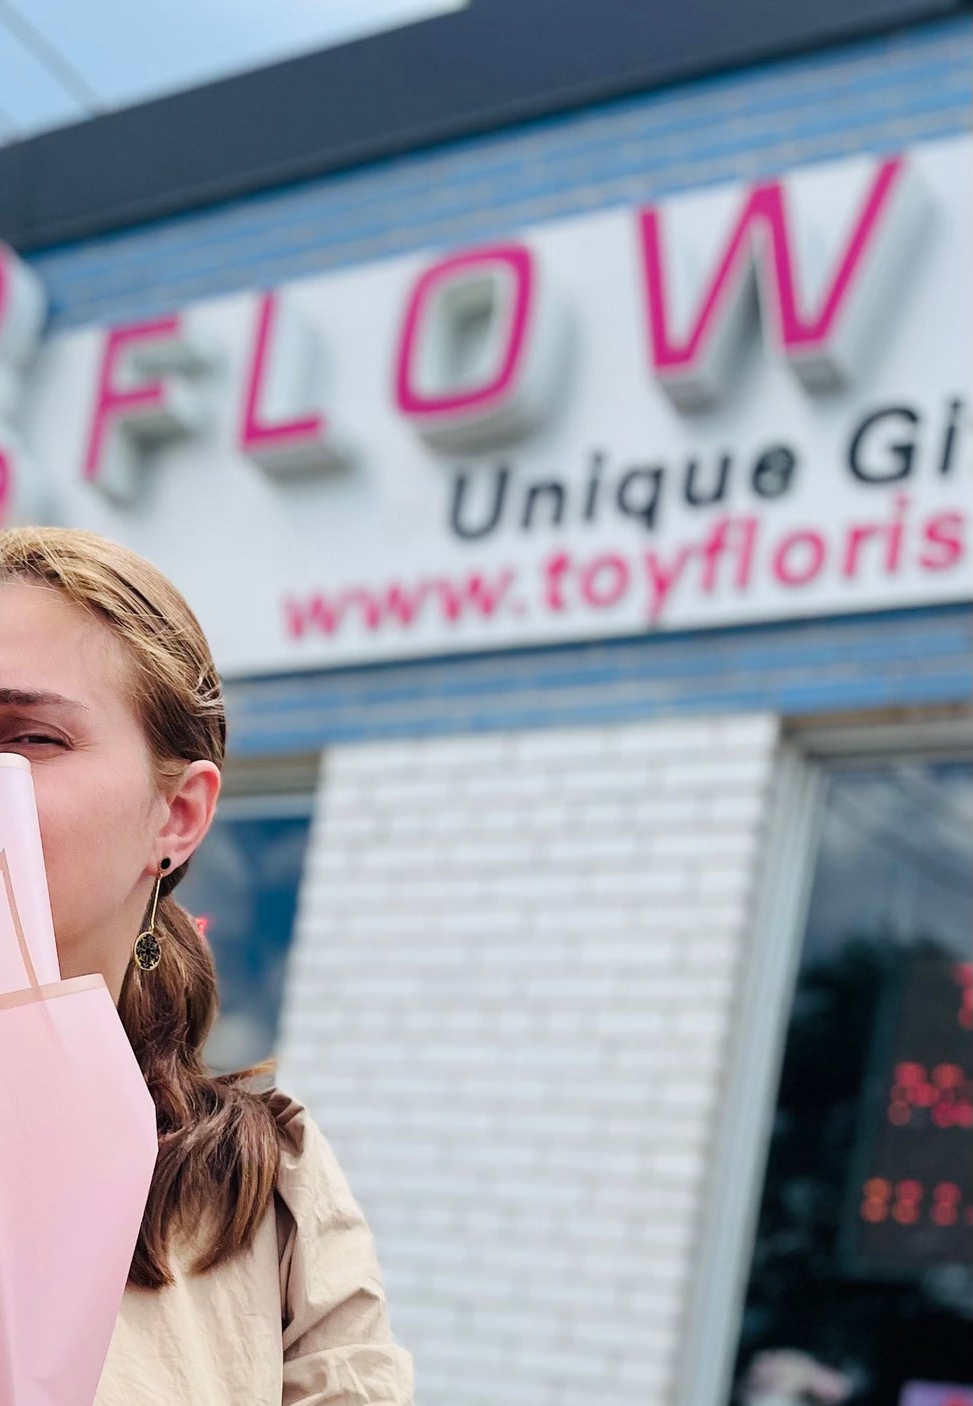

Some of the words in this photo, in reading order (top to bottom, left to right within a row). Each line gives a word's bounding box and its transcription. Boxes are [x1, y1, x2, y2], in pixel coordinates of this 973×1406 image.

[83, 154, 911, 484] FLOW
[448, 445, 799, 542] Unique
[847, 397, 962, 487] Gi
[281, 490, 965, 643] www.toyfloris
